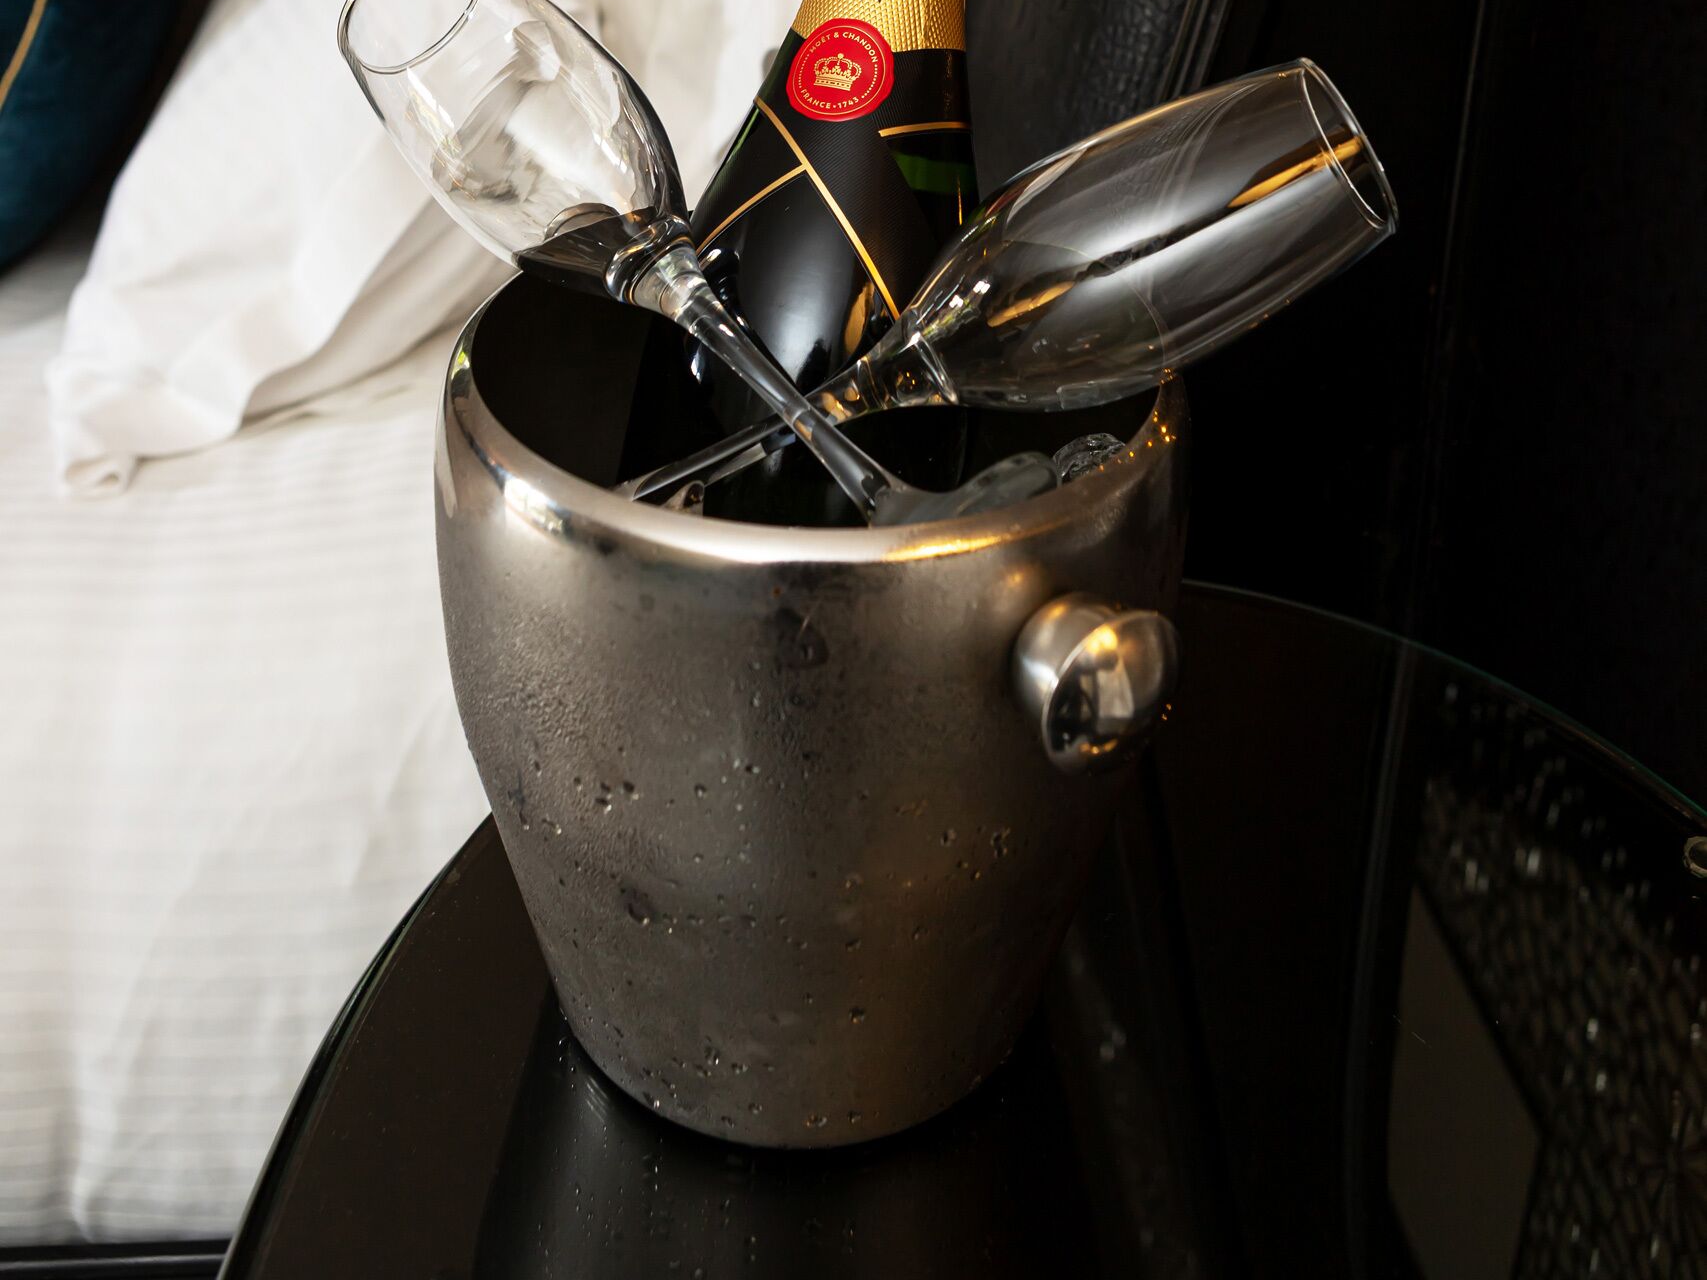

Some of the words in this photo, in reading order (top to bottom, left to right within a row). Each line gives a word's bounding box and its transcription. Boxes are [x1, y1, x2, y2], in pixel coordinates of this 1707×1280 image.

[833, 31, 840, 39] &
[842, 31, 879, 63] CHANDON
[800, 89, 831, 109] FRANCE
[837, 96, 859, 109] 1743
